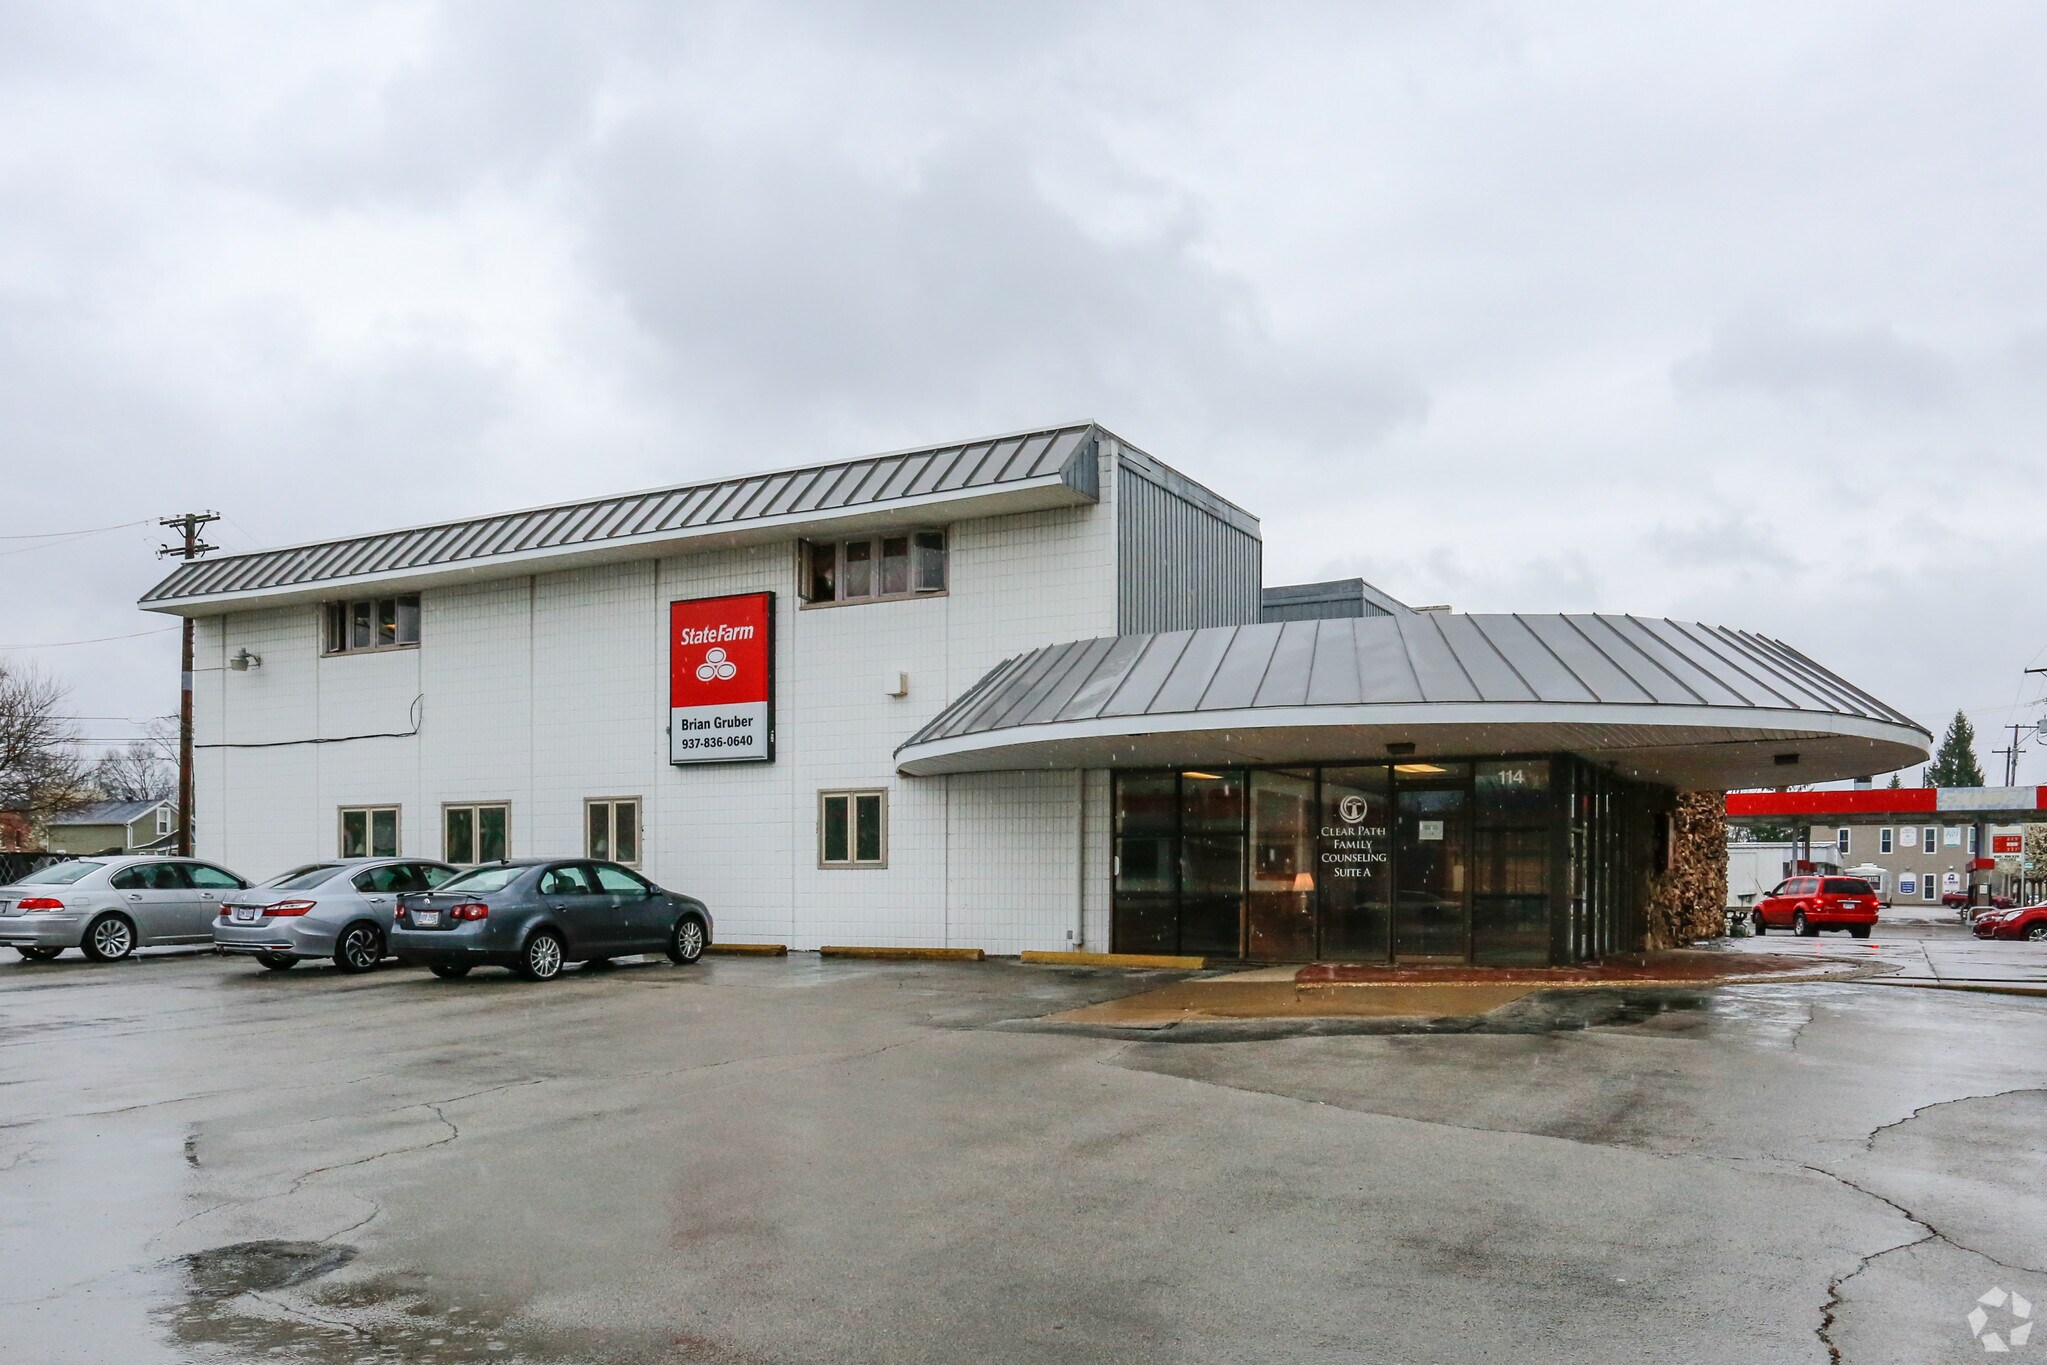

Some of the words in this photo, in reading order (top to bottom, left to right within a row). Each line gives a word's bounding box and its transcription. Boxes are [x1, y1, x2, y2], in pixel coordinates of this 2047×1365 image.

[681, 718, 711, 731] Brian
[714, 715, 753, 729] Gruber
[682, 735, 753, 749] 937-836-0640
[1498, 770, 1525, 784] 114
[1321, 826, 1355, 837] CLEAR
[1358, 826, 1386, 836] PATH
[1334, 840, 1373, 849] FAMILY
[1321, 853, 1387, 863] COUNSELING
[1334, 867, 1362, 877] SUITE
[1363, 868, 1371, 877] A
